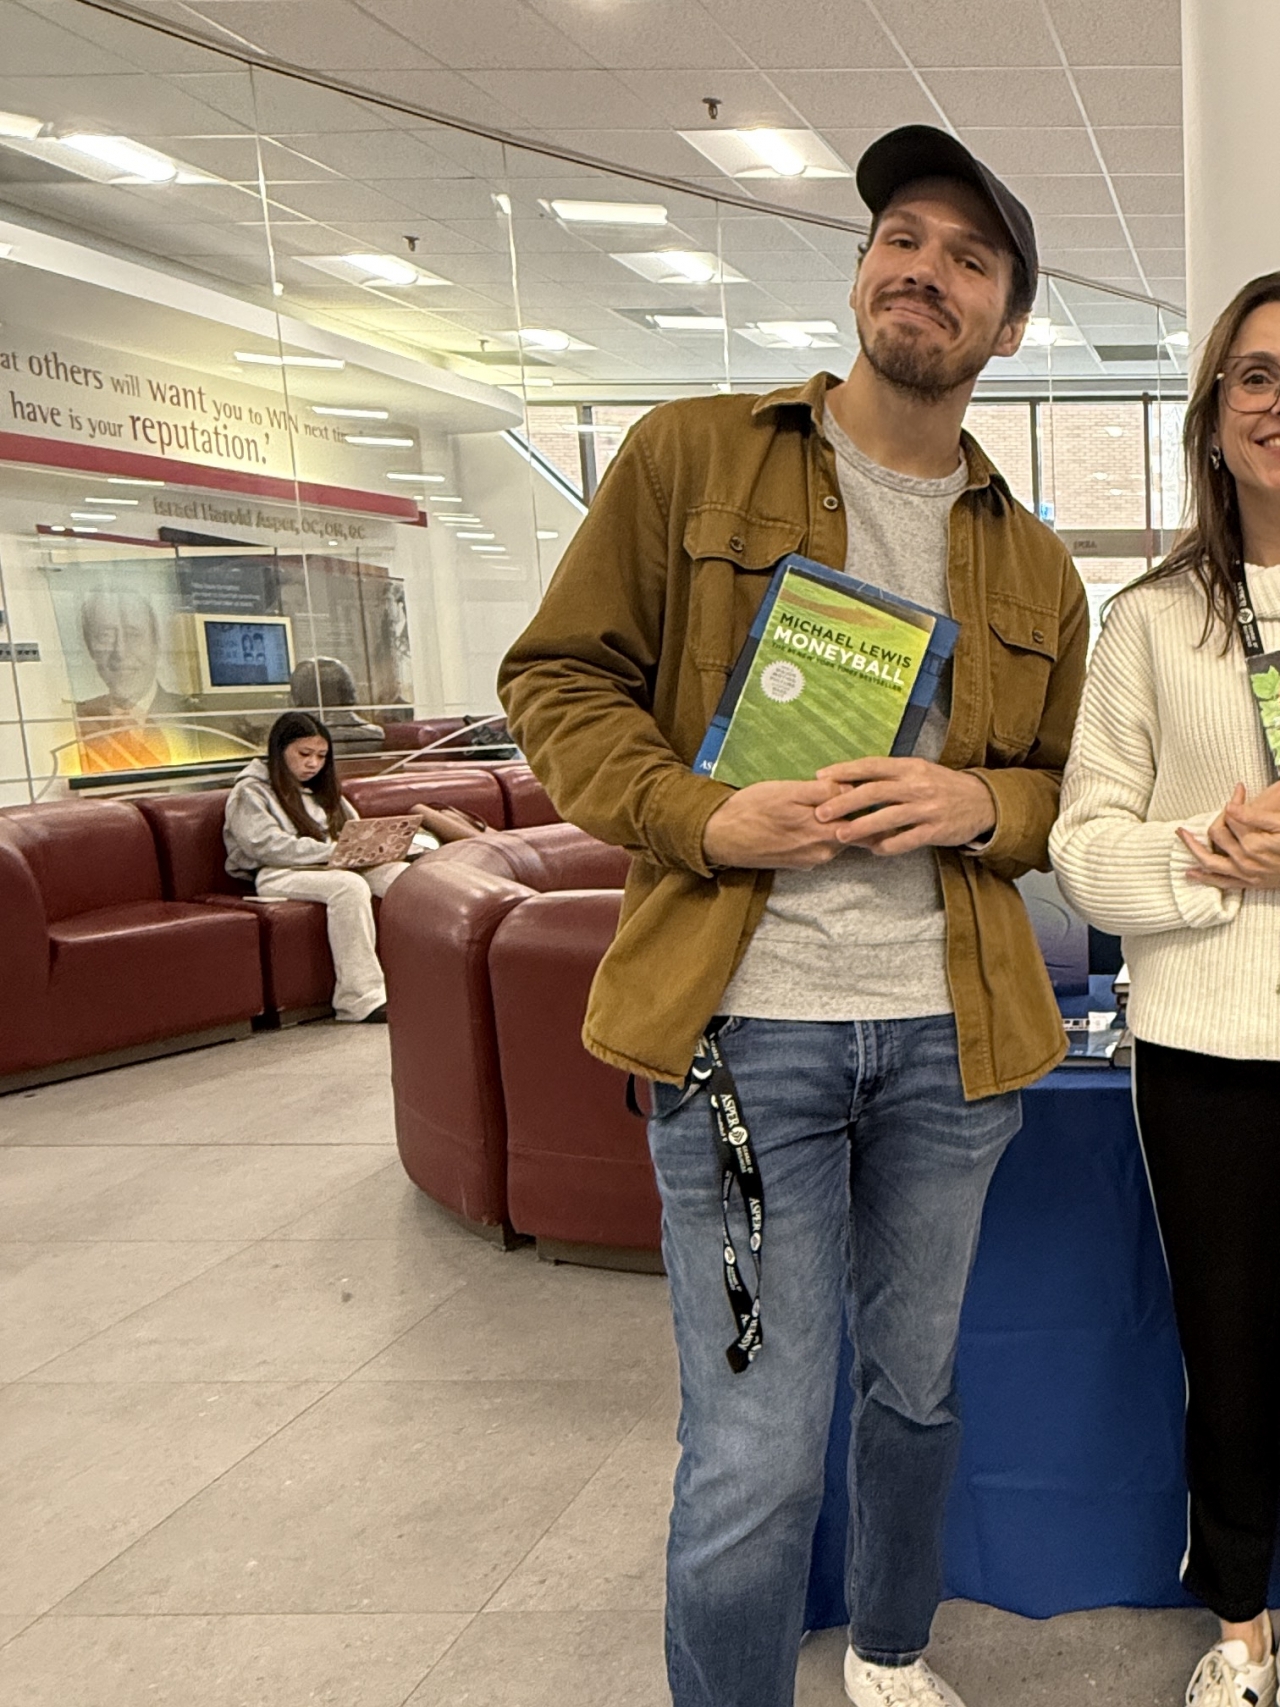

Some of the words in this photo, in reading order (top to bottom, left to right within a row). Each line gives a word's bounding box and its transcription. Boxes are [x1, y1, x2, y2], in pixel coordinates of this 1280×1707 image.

[9, 390, 62, 427] have
[68, 408, 83, 431] is
[88, 417, 124, 439] your
[28, 351, 104, 390] others
[110, 374, 141, 397] will
[147, 379, 208, 414] want
[212, 399, 242, 421] you
[248, 407, 263, 425] to
[266, 406, 299, 434] WIN
[304, 422, 330, 441] next
[153, 497, 197, 519] Israel
[201, 502, 251, 527] Harold
[773, 625, 905, 686] MONEYBALL
[780, 612, 854, 649] MICHAEL
[859, 641, 912, 669] LEWIS
[720, 1093, 740, 1127] ASPER
[749, 1196, 762, 1232] ASPER
